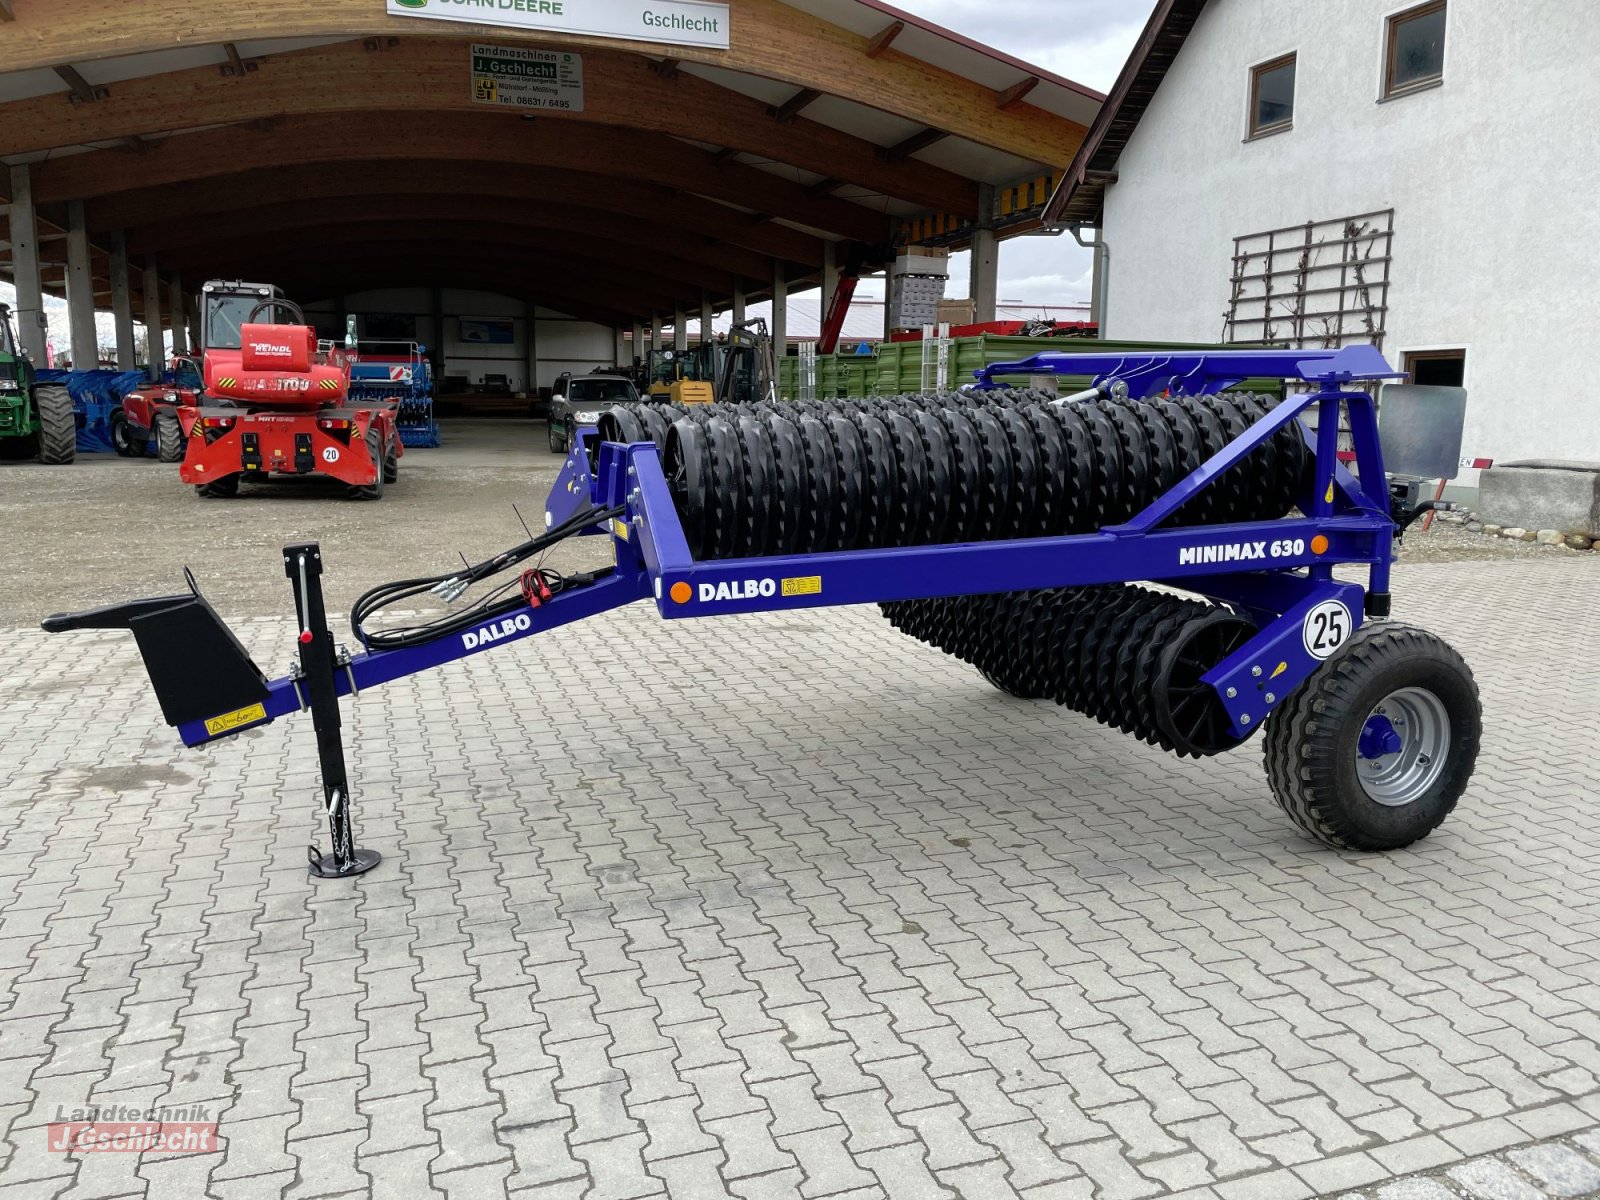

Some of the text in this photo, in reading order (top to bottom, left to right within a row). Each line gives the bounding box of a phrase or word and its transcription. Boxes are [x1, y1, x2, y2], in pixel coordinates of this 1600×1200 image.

[498, 0, 563, 15] DEERE
[642, 10, 718, 33] Gschlecht
[472, 45, 557, 61] Landmaschinen
[476, 59, 554, 77] J. Gschlecht
[498, 95, 514, 103] Tel.
[549, 100, 570, 108] 6495
[326, 450, 337, 460] 20
[1179, 538, 1305, 565] MINIMAX 630
[698, 578, 777, 602] DALBO
[461, 613, 532, 650] DALBO
[1313, 610, 1343, 650] 25
